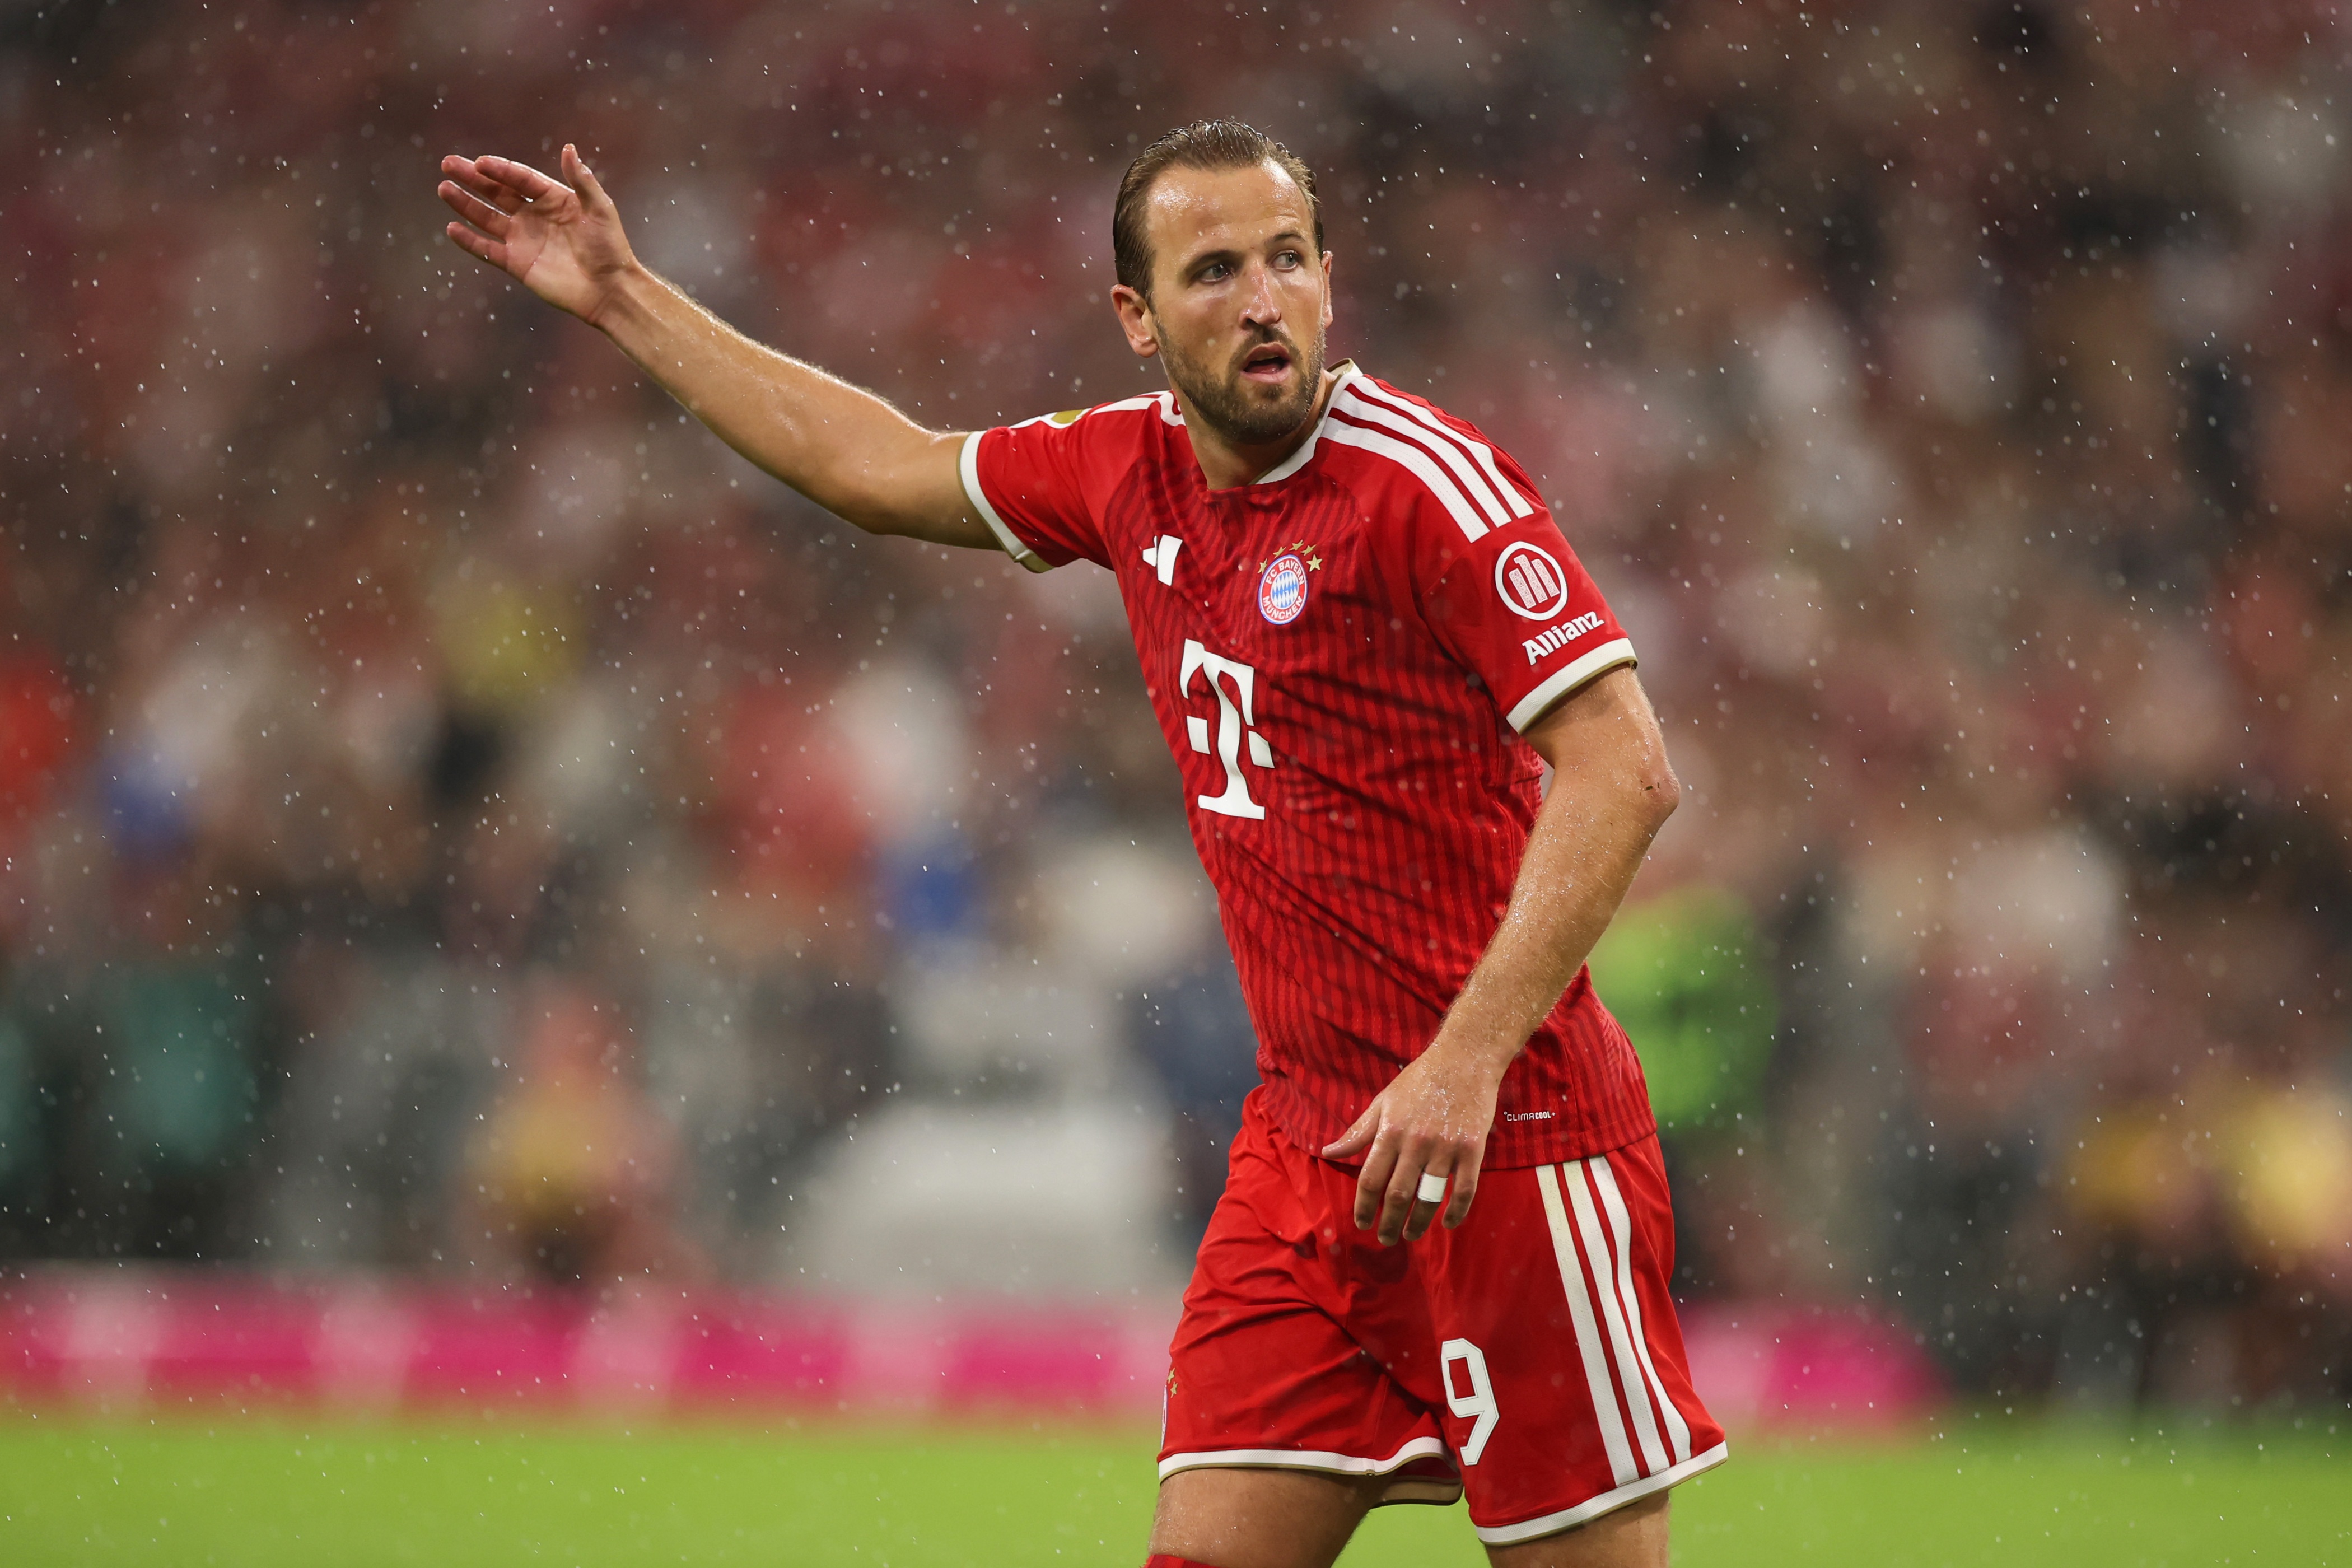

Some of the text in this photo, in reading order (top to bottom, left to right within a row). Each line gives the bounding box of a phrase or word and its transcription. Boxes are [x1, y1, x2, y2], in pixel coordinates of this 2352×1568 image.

[1266, 561, 1304, 585] FC BAYERN
[1522, 612, 1604, 665] Allianz
[1180, 638, 1275, 820] T
[1441, 1338, 1499, 1466] 9
